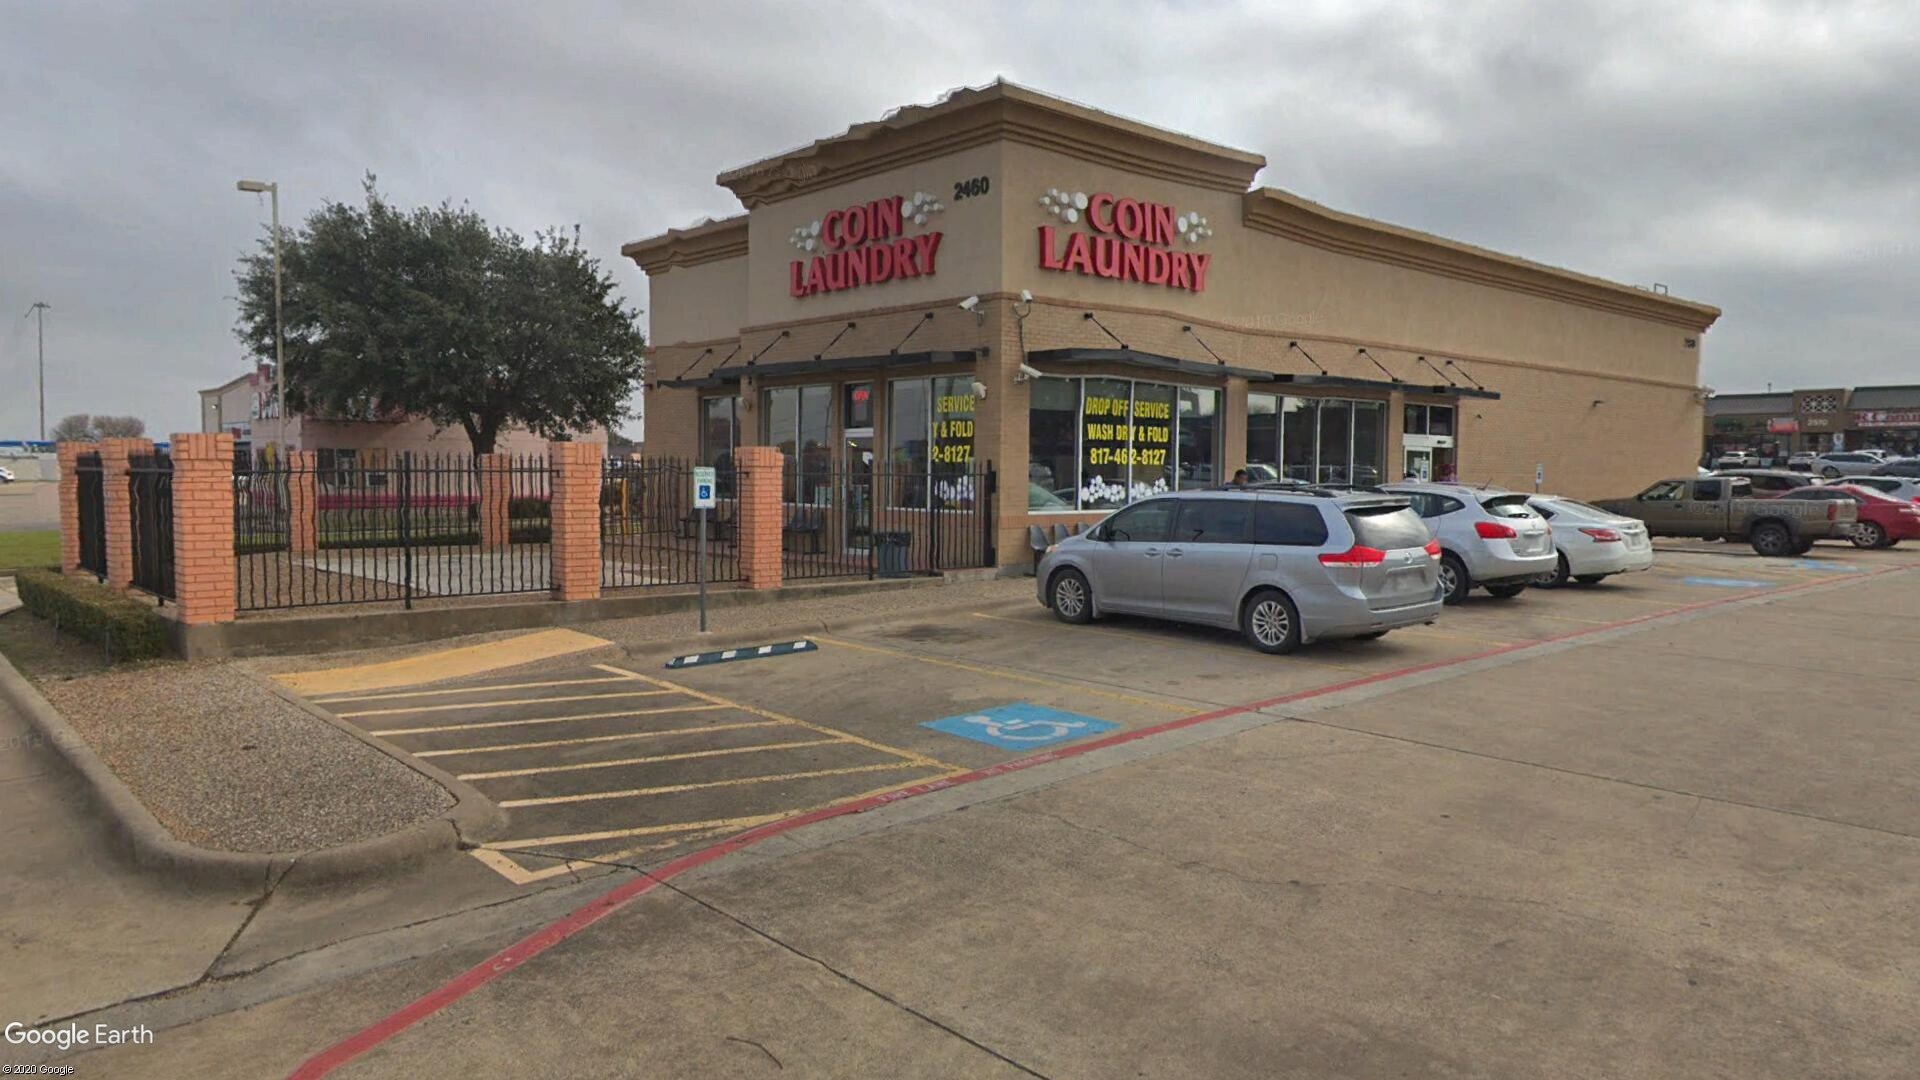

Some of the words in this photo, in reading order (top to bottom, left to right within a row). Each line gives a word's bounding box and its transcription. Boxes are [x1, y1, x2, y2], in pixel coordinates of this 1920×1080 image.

[953, 175, 990, 201] 2460
[822, 194, 904, 250] COIN
[1086, 192, 1176, 246] COIN
[790, 231, 943, 299] LAUNDRY
[1038, 223, 1212, 292] LAUNDRY
[936, 394, 976, 413] SERVICE
[1085, 397, 1111, 416] DROP
[1111, 399, 1129, 417] OFF
[1134, 401, 1170, 419] SERVICE
[940, 421, 948, 438] &
[950, 421, 974, 438] FOLD
[1087, 423, 1114, 441] WASH
[1138, 426, 1146, 442] &
[1147, 426, 1169, 443] FOLD
[1090, 447, 1167, 466] 817-462-8127
